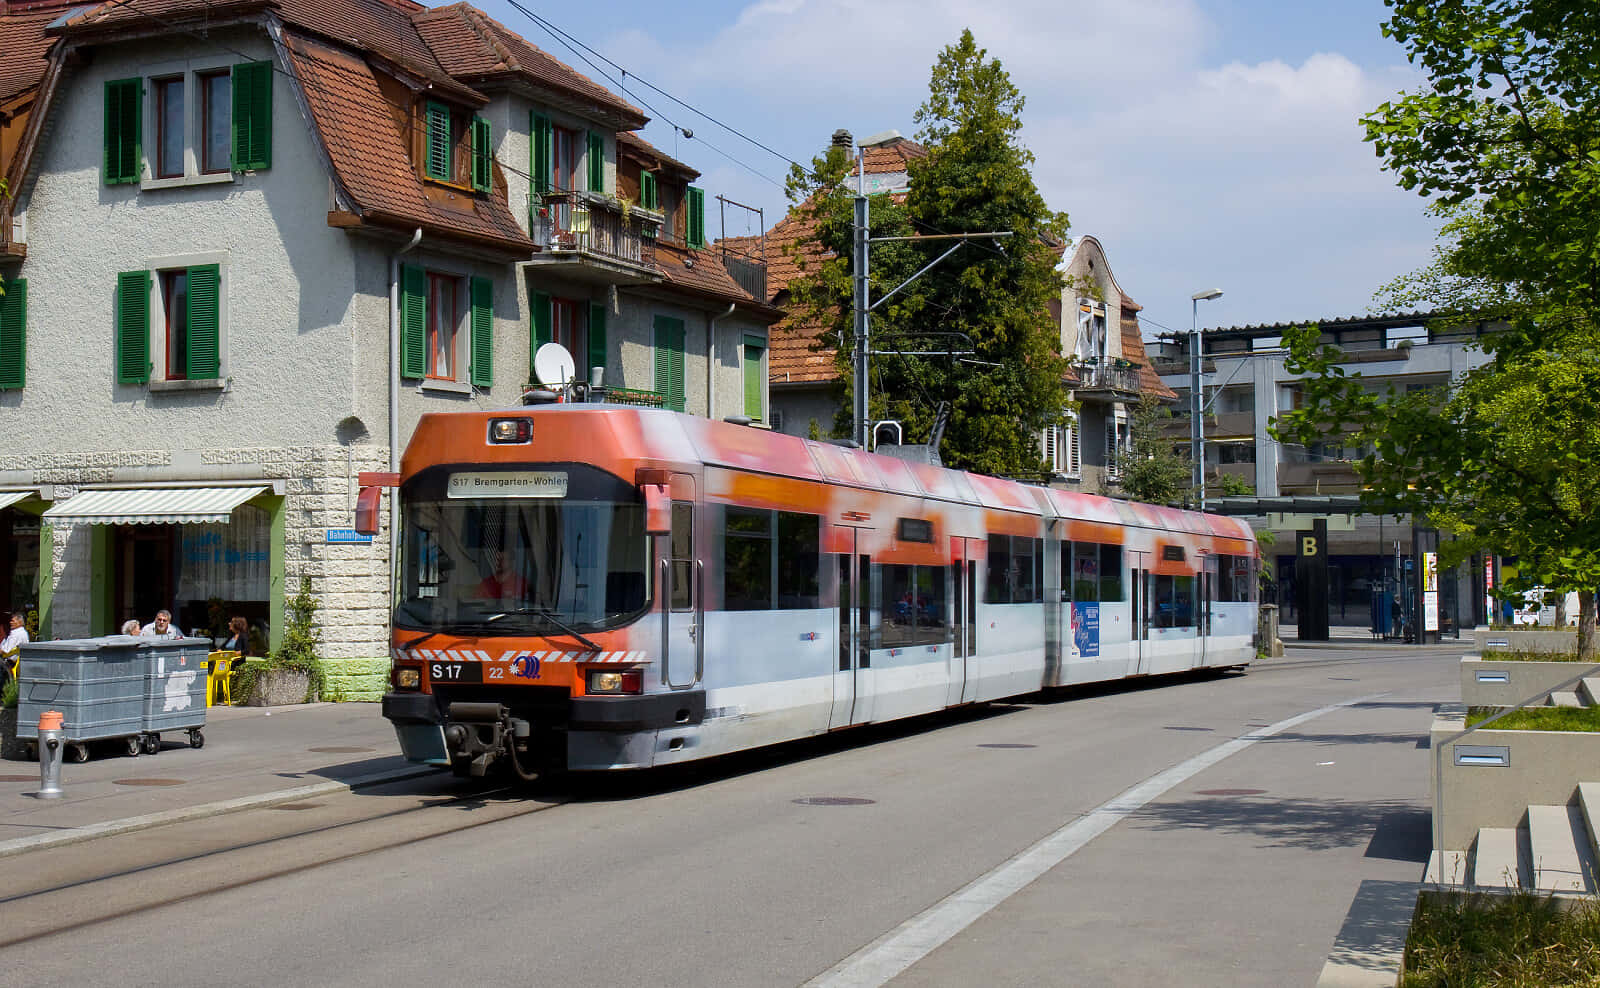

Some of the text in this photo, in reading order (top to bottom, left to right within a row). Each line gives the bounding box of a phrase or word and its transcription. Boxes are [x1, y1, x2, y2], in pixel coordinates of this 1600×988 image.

[452, 477, 568, 488] S17 Bremgarten-Wohlen
[1303, 536, 1318, 556] B
[489, 667, 504, 679] 22
